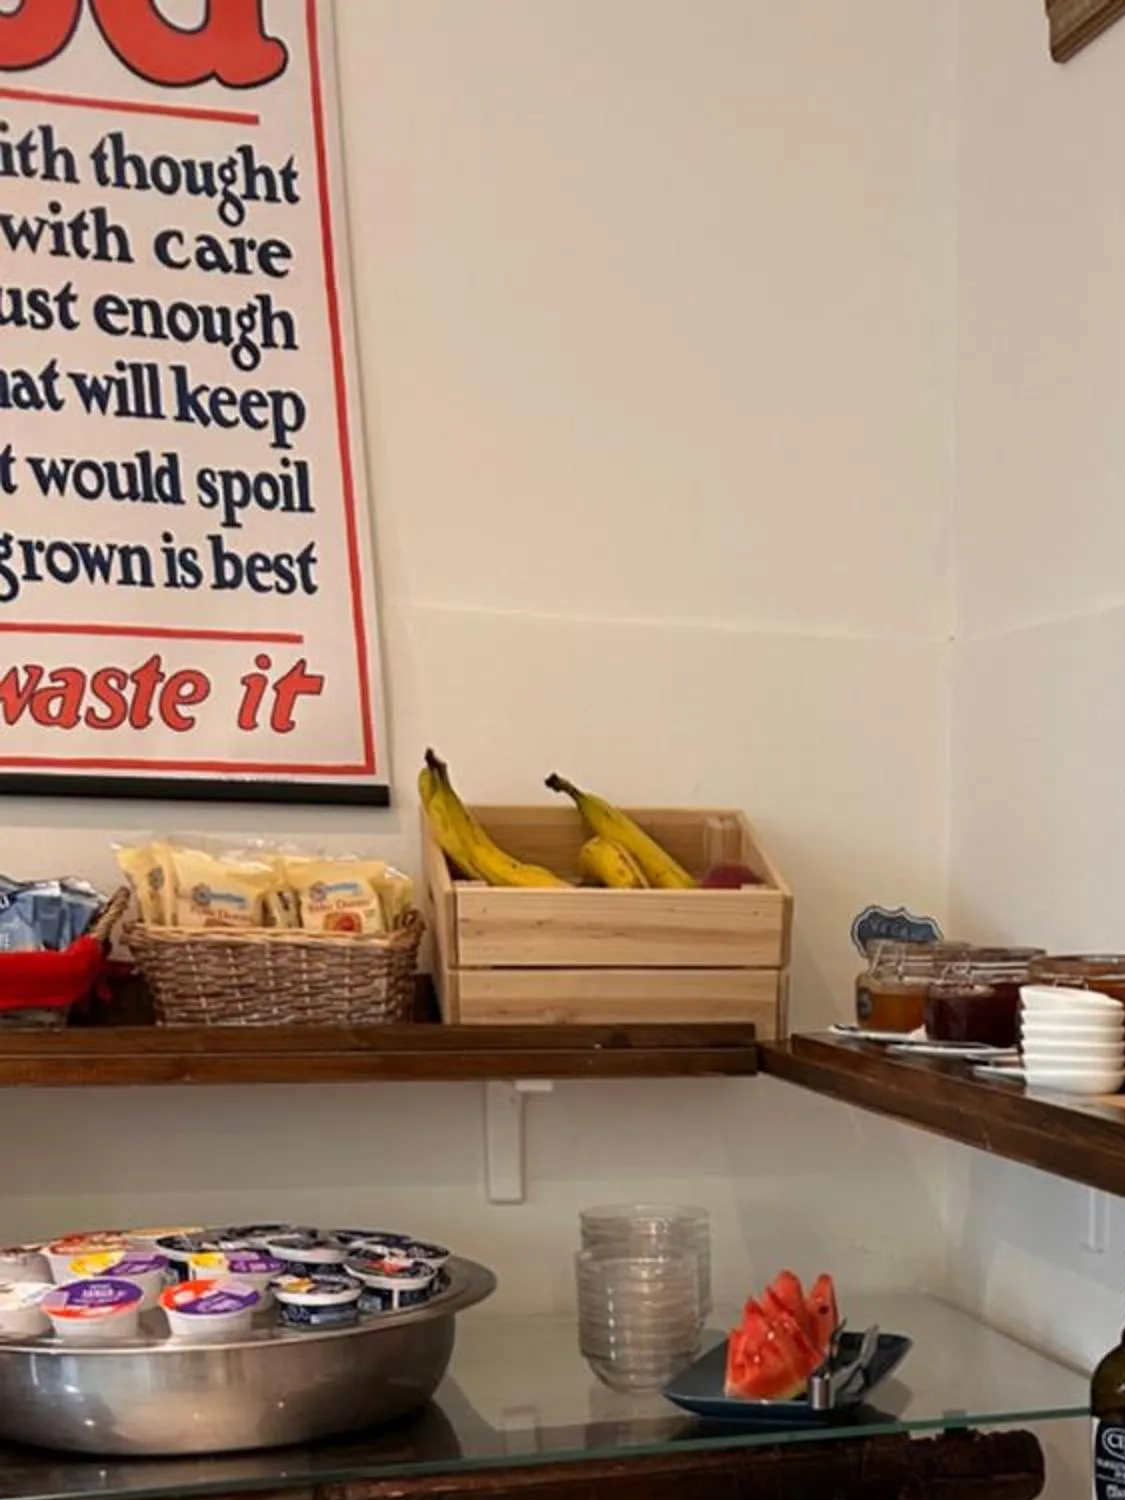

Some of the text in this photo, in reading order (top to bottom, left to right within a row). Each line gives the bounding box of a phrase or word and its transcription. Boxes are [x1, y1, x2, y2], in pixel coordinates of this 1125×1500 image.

[90, 131, 301, 227] thought
[0, 202, 292, 278] with care
[93, 295, 299, 371] enough
[67, 360, 165, 419] will
[170, 365, 306, 449] keep
[26, 449, 186, 505] would
[197, 458, 315, 527] spoil
[163, 532, 200, 589] is
[207, 534, 318, 595] best
[237, 653, 325, 734] it
